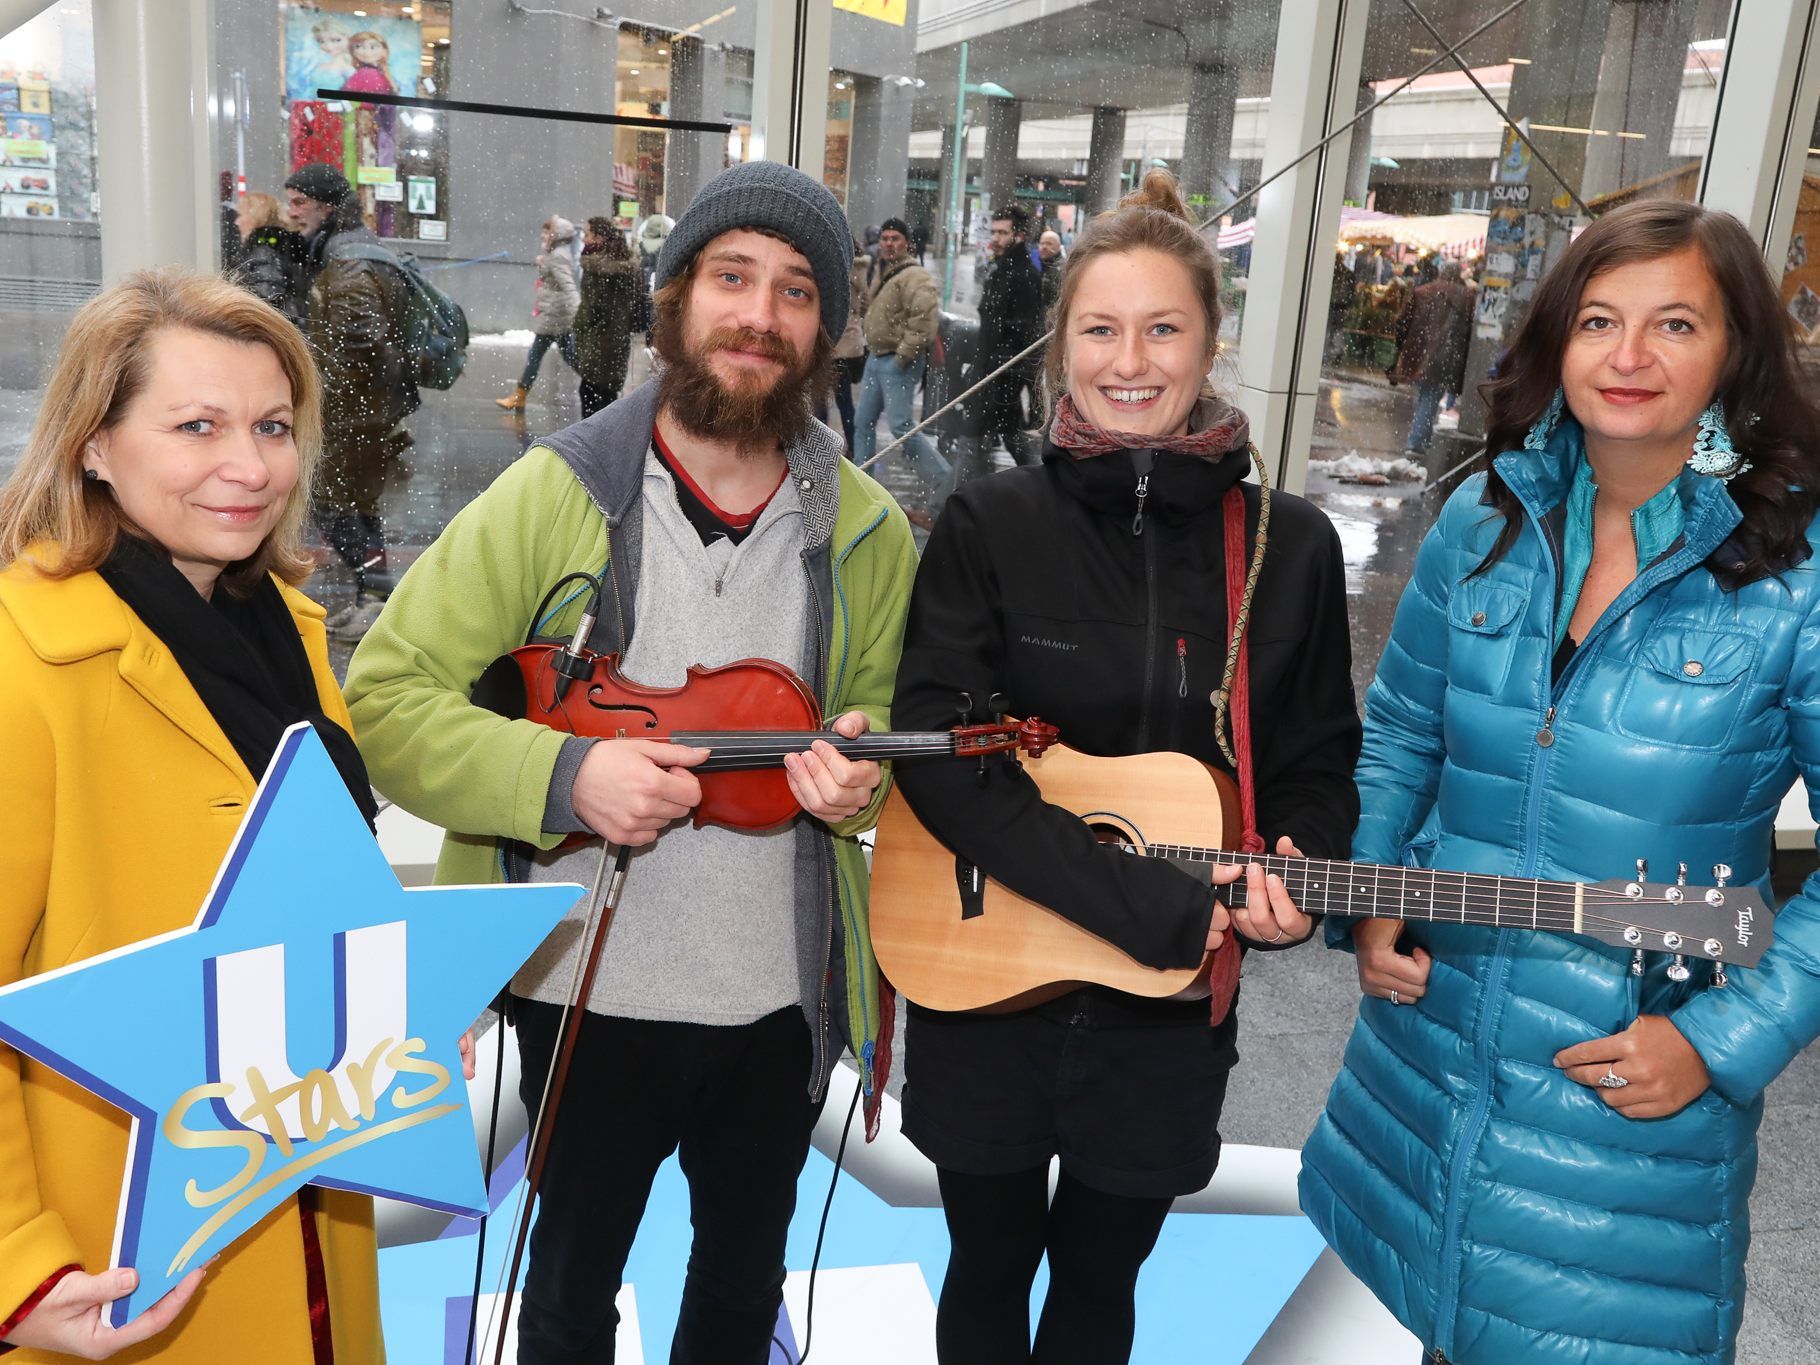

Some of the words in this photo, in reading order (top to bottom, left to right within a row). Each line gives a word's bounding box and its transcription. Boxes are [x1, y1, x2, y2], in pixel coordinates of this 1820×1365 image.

[1493, 184, 1529, 200] ISLAND
[1020, 635, 1079, 651] MAMMUT
[1734, 906, 1754, 948] Taylor
[203, 919, 407, 1144] U
[163, 1037, 451, 1208] Stars
